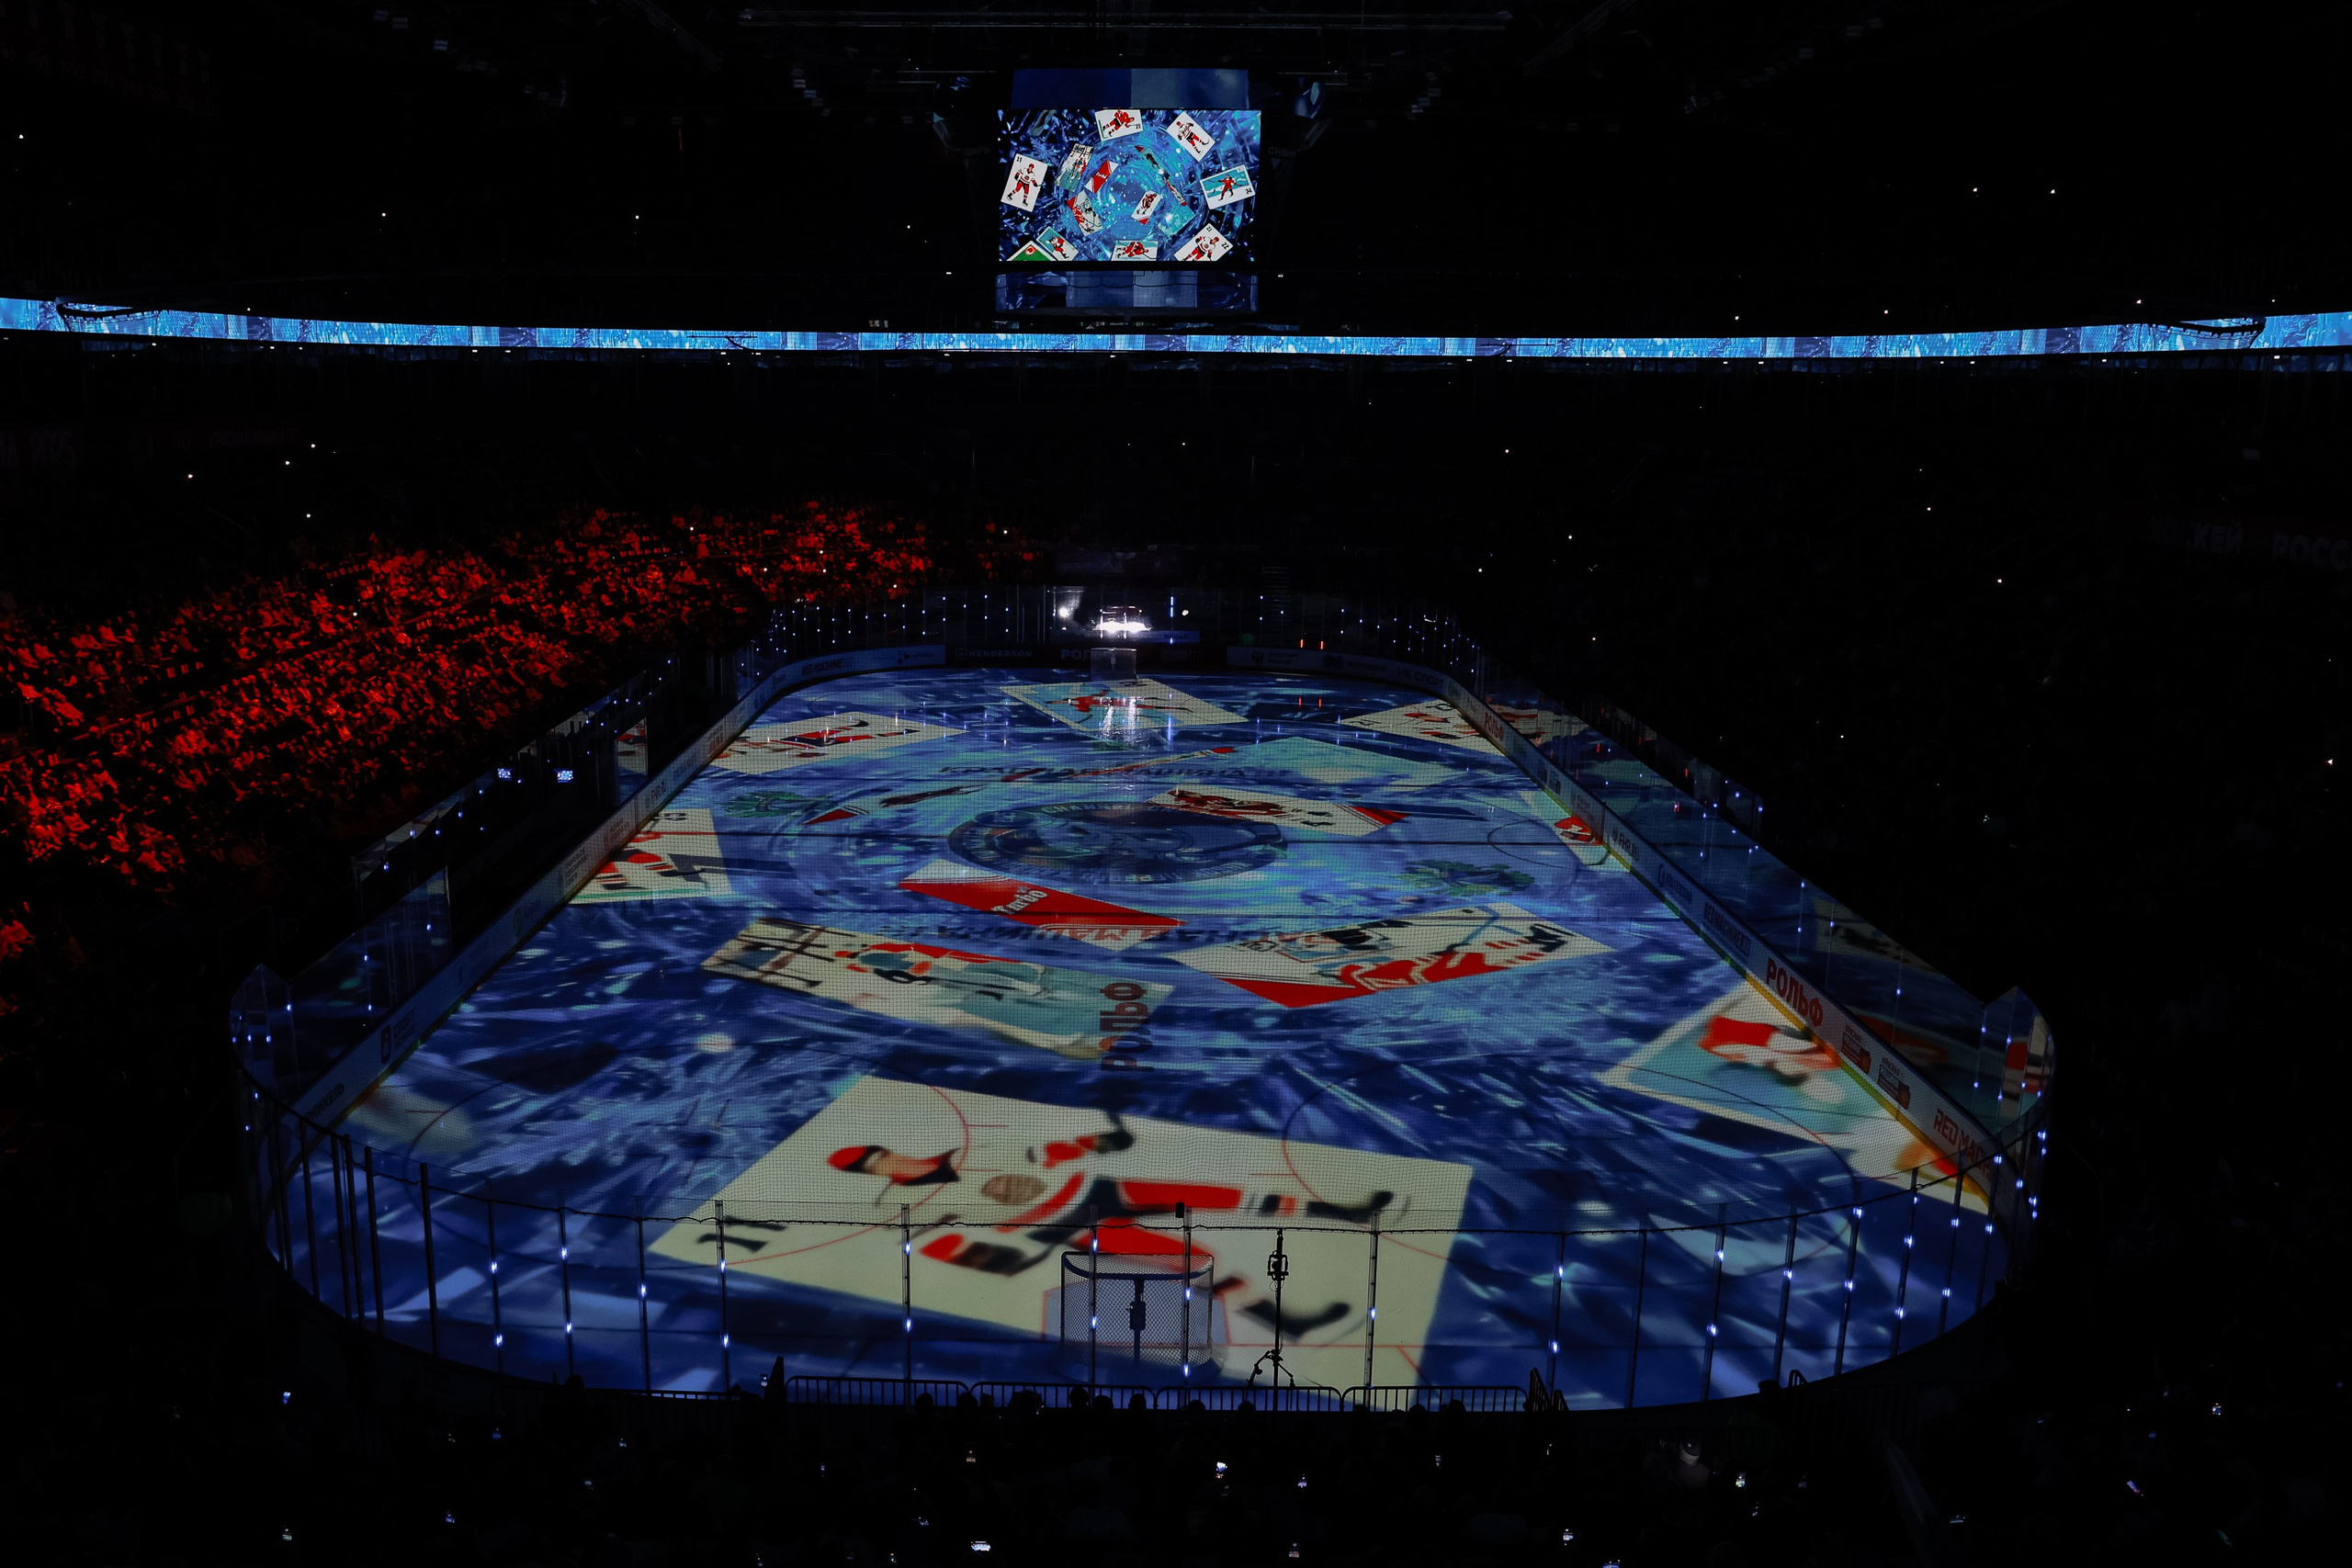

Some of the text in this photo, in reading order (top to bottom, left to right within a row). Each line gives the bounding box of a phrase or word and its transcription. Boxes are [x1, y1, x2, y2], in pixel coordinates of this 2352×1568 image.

[968, 649, 1034, 660] HENDERSON
[1415, 670, 1444, 687] СПОРТ
[1767, 957, 1824, 1027] РОЛЬФ
[1099, 982, 1155, 1072] РОЛЬФ
[1934, 1108, 1959, 1146] RED
